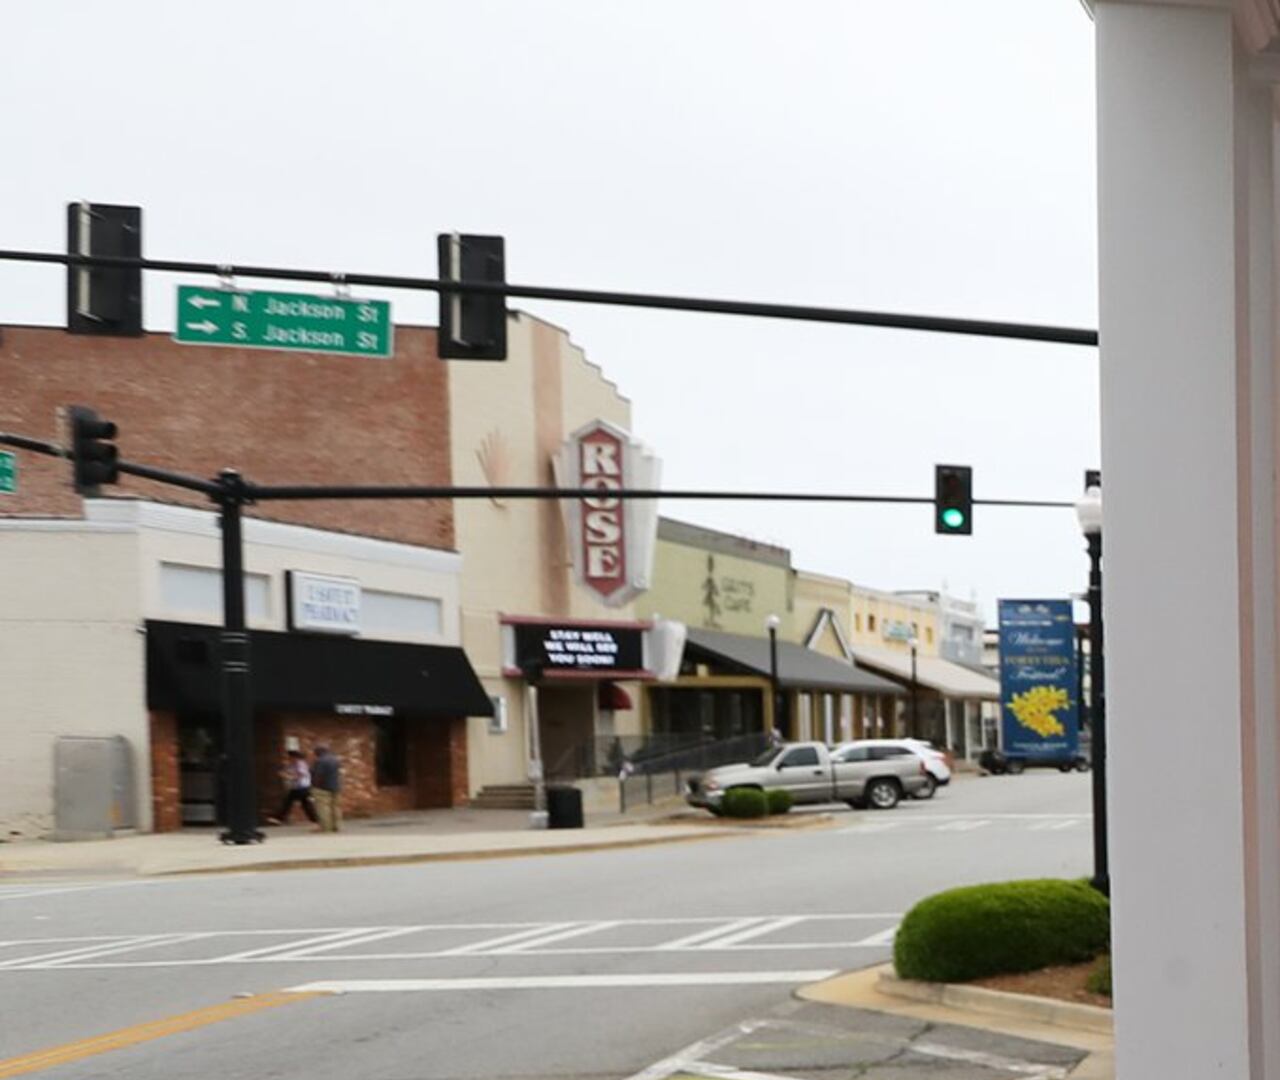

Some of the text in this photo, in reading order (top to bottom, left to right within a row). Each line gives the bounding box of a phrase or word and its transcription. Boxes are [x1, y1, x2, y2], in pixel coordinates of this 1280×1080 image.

[263, 298, 346, 320] Jackson
[356, 305, 379, 324] St
[262, 324, 345, 347] Jackson
[355, 331, 379, 350] St
[581, 442, 622, 578] ROSE
